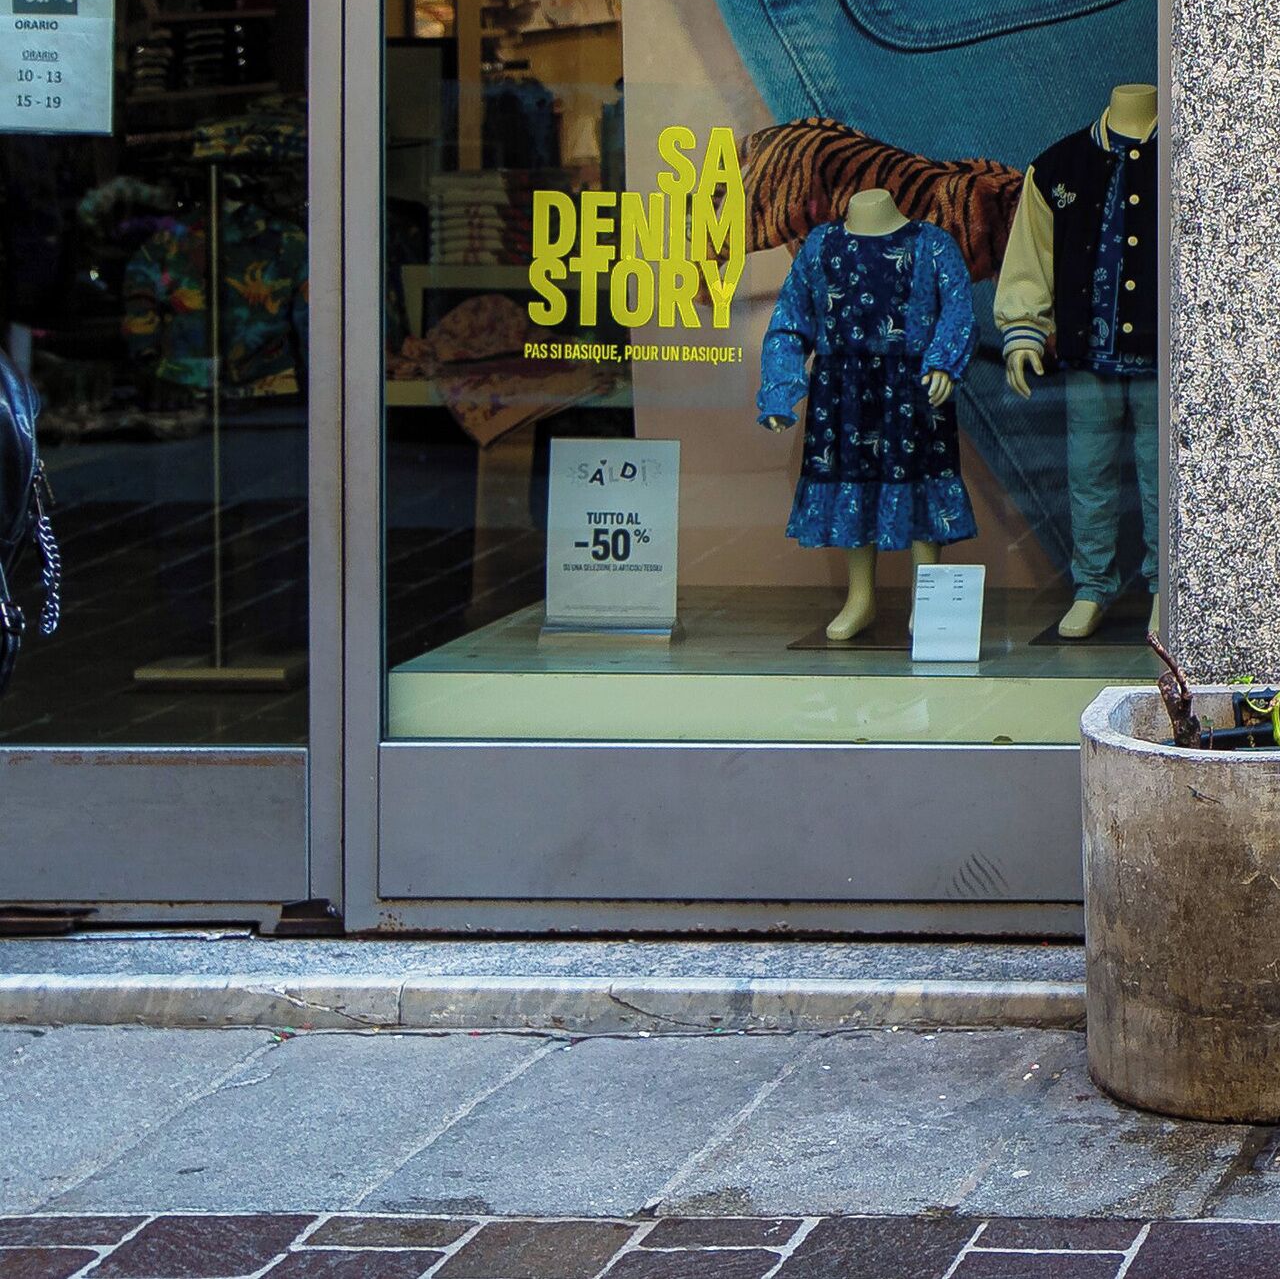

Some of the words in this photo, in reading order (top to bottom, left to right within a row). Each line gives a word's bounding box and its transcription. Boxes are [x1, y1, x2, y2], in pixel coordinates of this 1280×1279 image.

[15, 20, 58, 31] ORARIO
[22, 50, 59, 62] ORARIO
[17, 69, 33, 82] 10
[46, 70, 62, 83] 13
[16, 95, 32, 108] 15
[45, 96, 62, 109] 19
[657, 127, 743, 196] SA
[533, 191, 746, 262] DENIM
[528, 258, 744, 328] STORY
[524, 343, 548, 360] PAS
[550, 344, 562, 359] SI
[564, 344, 622, 364] BASIQUE,
[624, 344, 660, 361] POUR
[661, 345, 680, 361] UN
[682, 346, 736, 365] BASIQUE
[587, 512, 624, 525] TUTTO
[625, 512, 642, 525] AL
